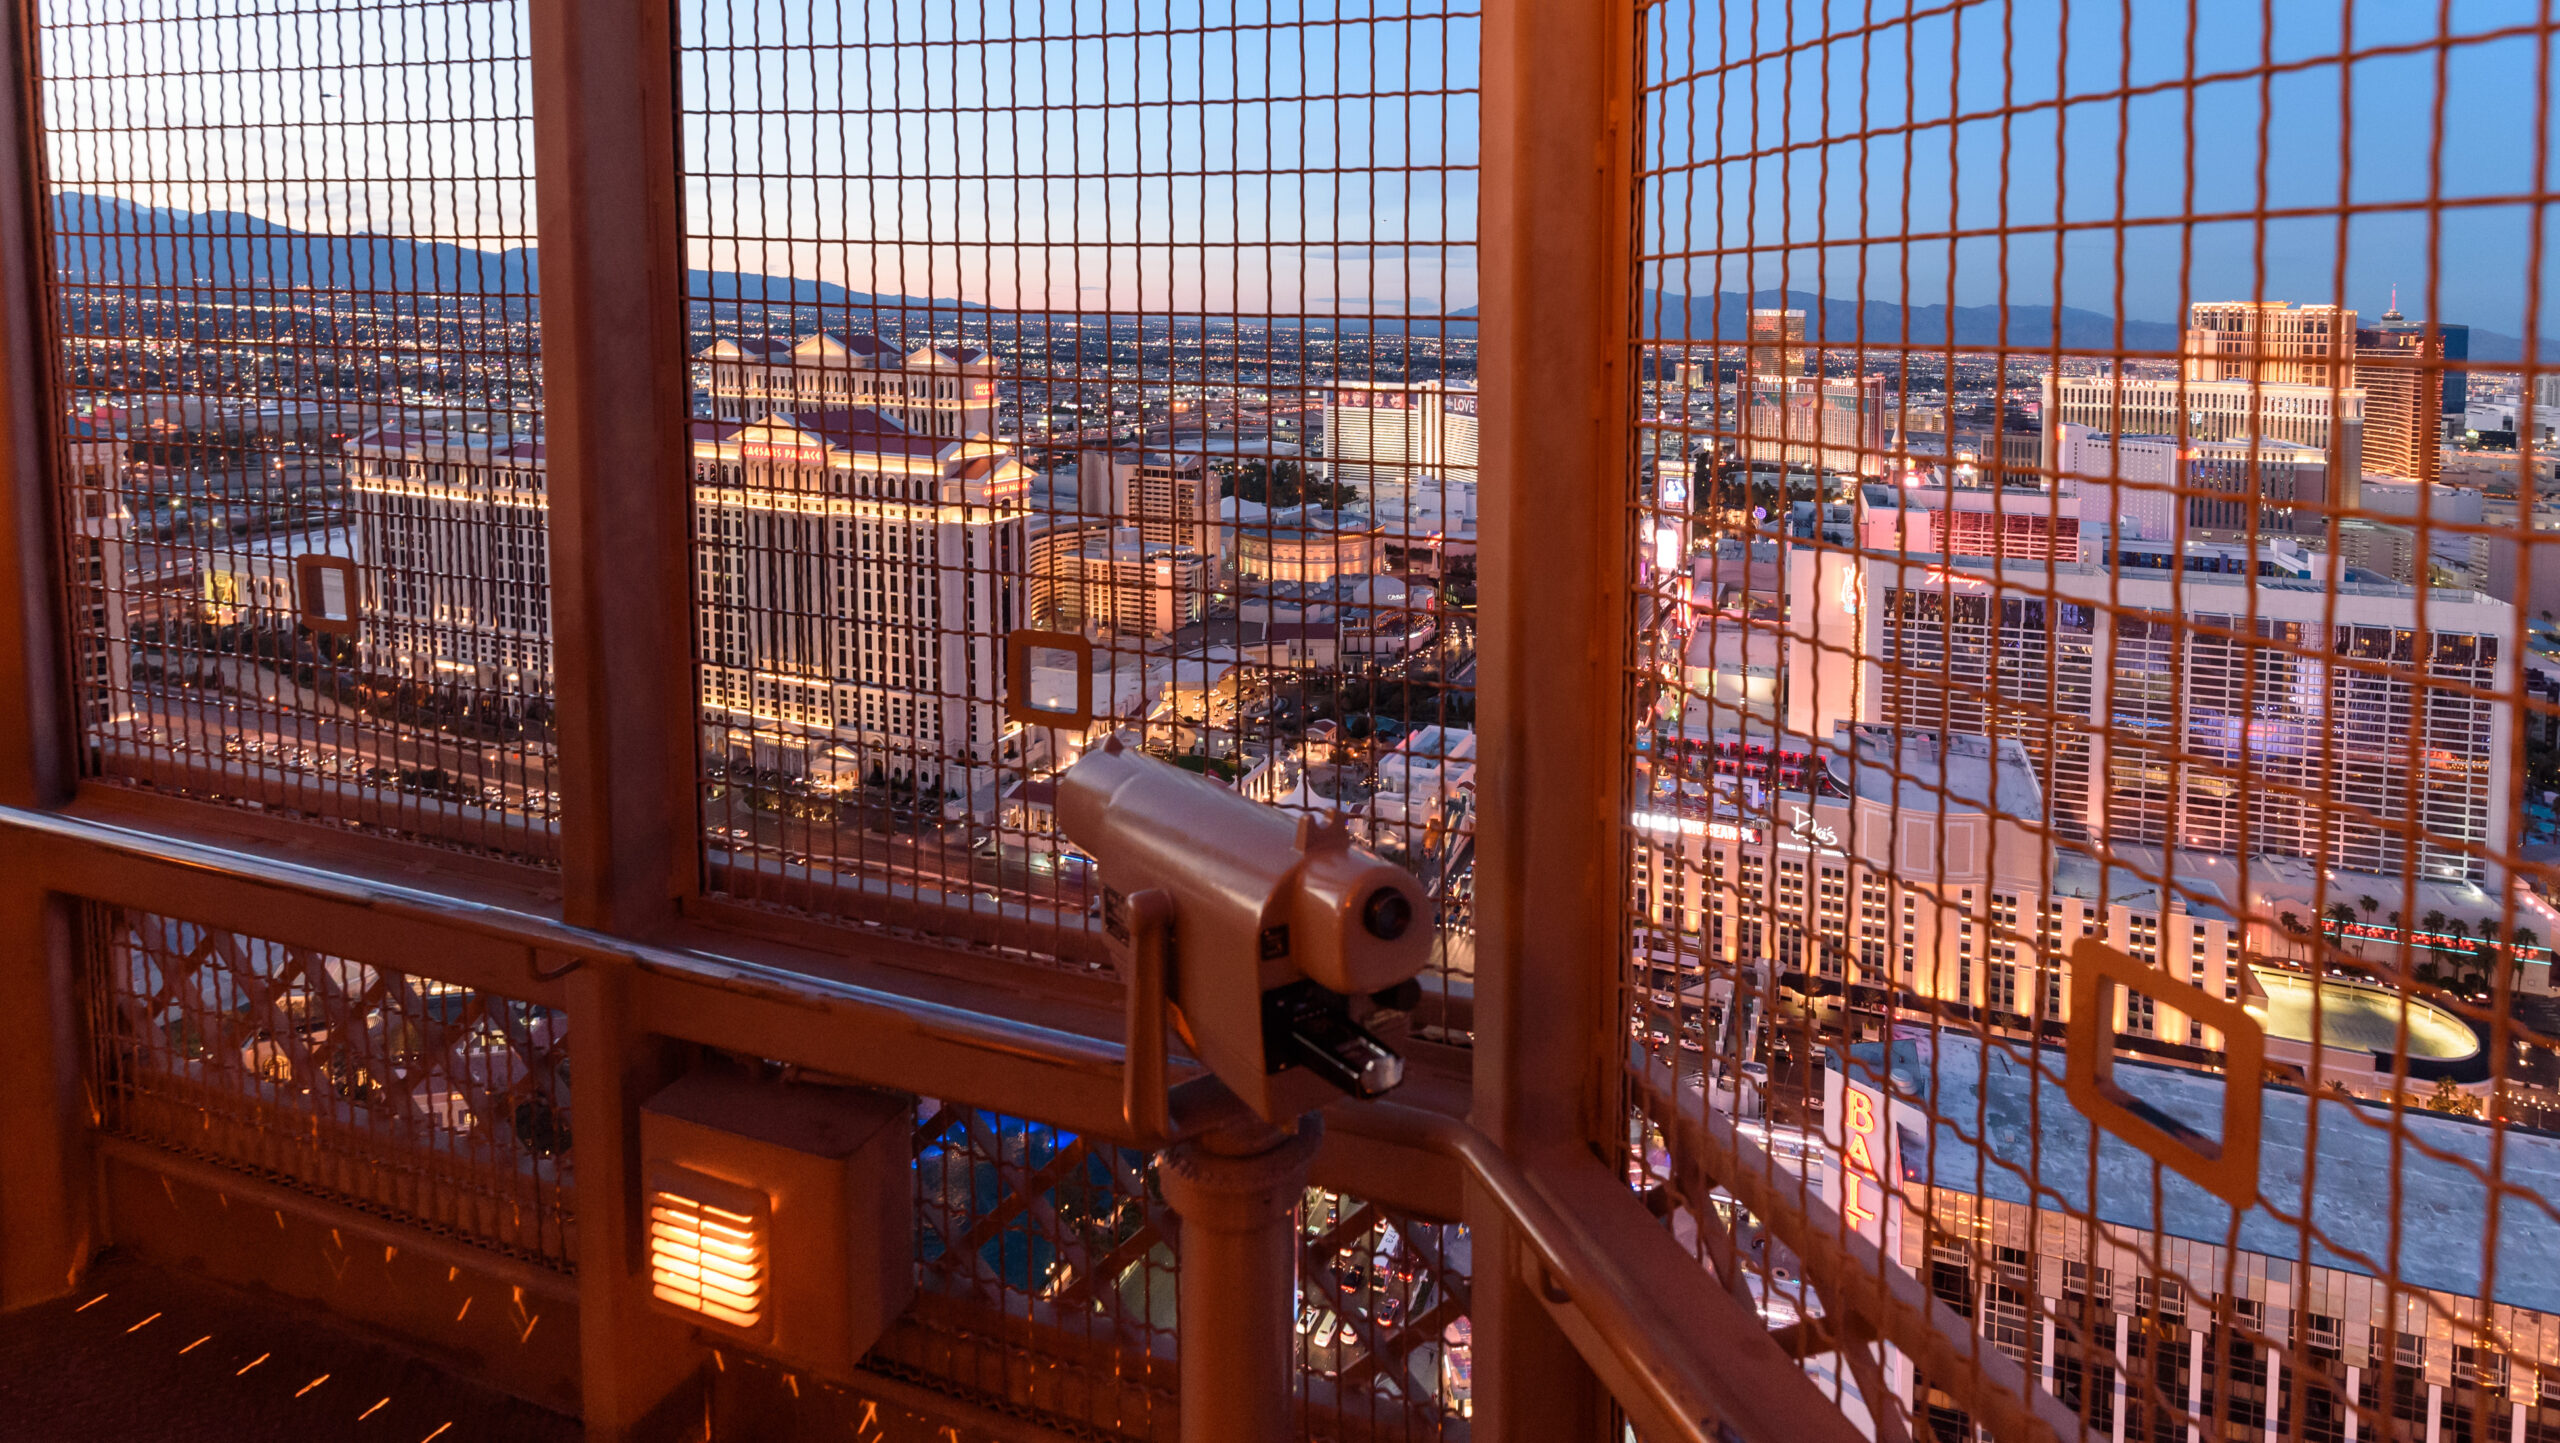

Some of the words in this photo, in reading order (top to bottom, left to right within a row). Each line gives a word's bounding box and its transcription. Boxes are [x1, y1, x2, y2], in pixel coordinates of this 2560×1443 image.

[2089, 378, 2154, 388] VENTIAN
[1453, 397, 1475, 414] LOVE
[984, 484, 1008, 496] CASARS
[1009, 480, 1029, 492] PALCE
[1923, 563, 1987, 590] Flmingo
